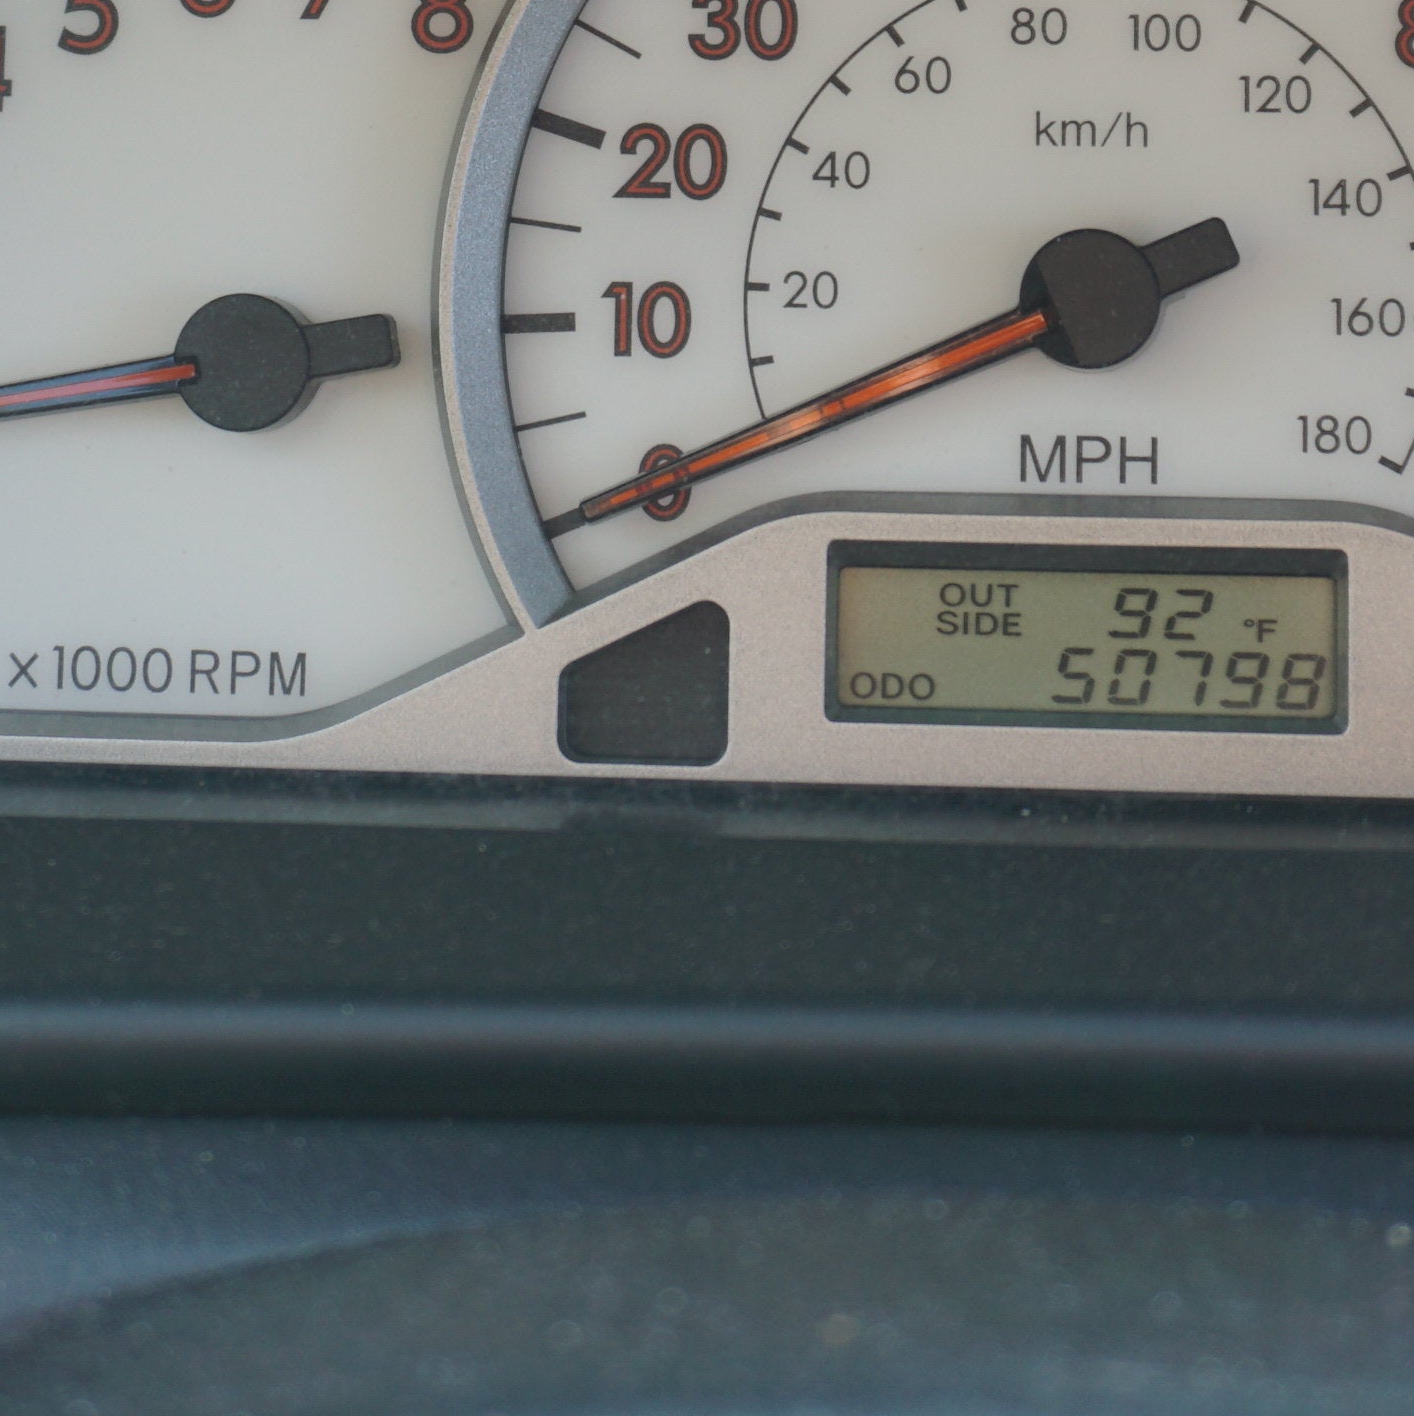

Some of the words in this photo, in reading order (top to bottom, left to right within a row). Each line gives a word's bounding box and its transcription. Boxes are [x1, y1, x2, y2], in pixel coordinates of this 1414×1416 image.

[1011, 8, 1067, 45] 80
[1129, 14, 1201, 52] 100
[895, 56, 951, 94] 60
[1240, 76, 1311, 113] 120
[1036, 111, 1147, 147] km/h
[613, 123, 727, 200] 20
[812, 150, 871, 191] 40
[1309, 179, 1382, 217] 140
[784, 271, 838, 309] 20
[601, 281, 691, 359] 10
[1331, 298, 1405, 337] 160
[1298, 415, 1371, 454] 180
[1021, 435, 1157, 484] MPH
[940, 583, 1019, 608] OUT
[1109, 588, 1213, 640] 92
[937, 611, 1021, 636] SIDE
[190, 650, 306, 696] RPM
[850, 672, 935, 700] ODO
[1051, 647, 1326, 710] 50798
